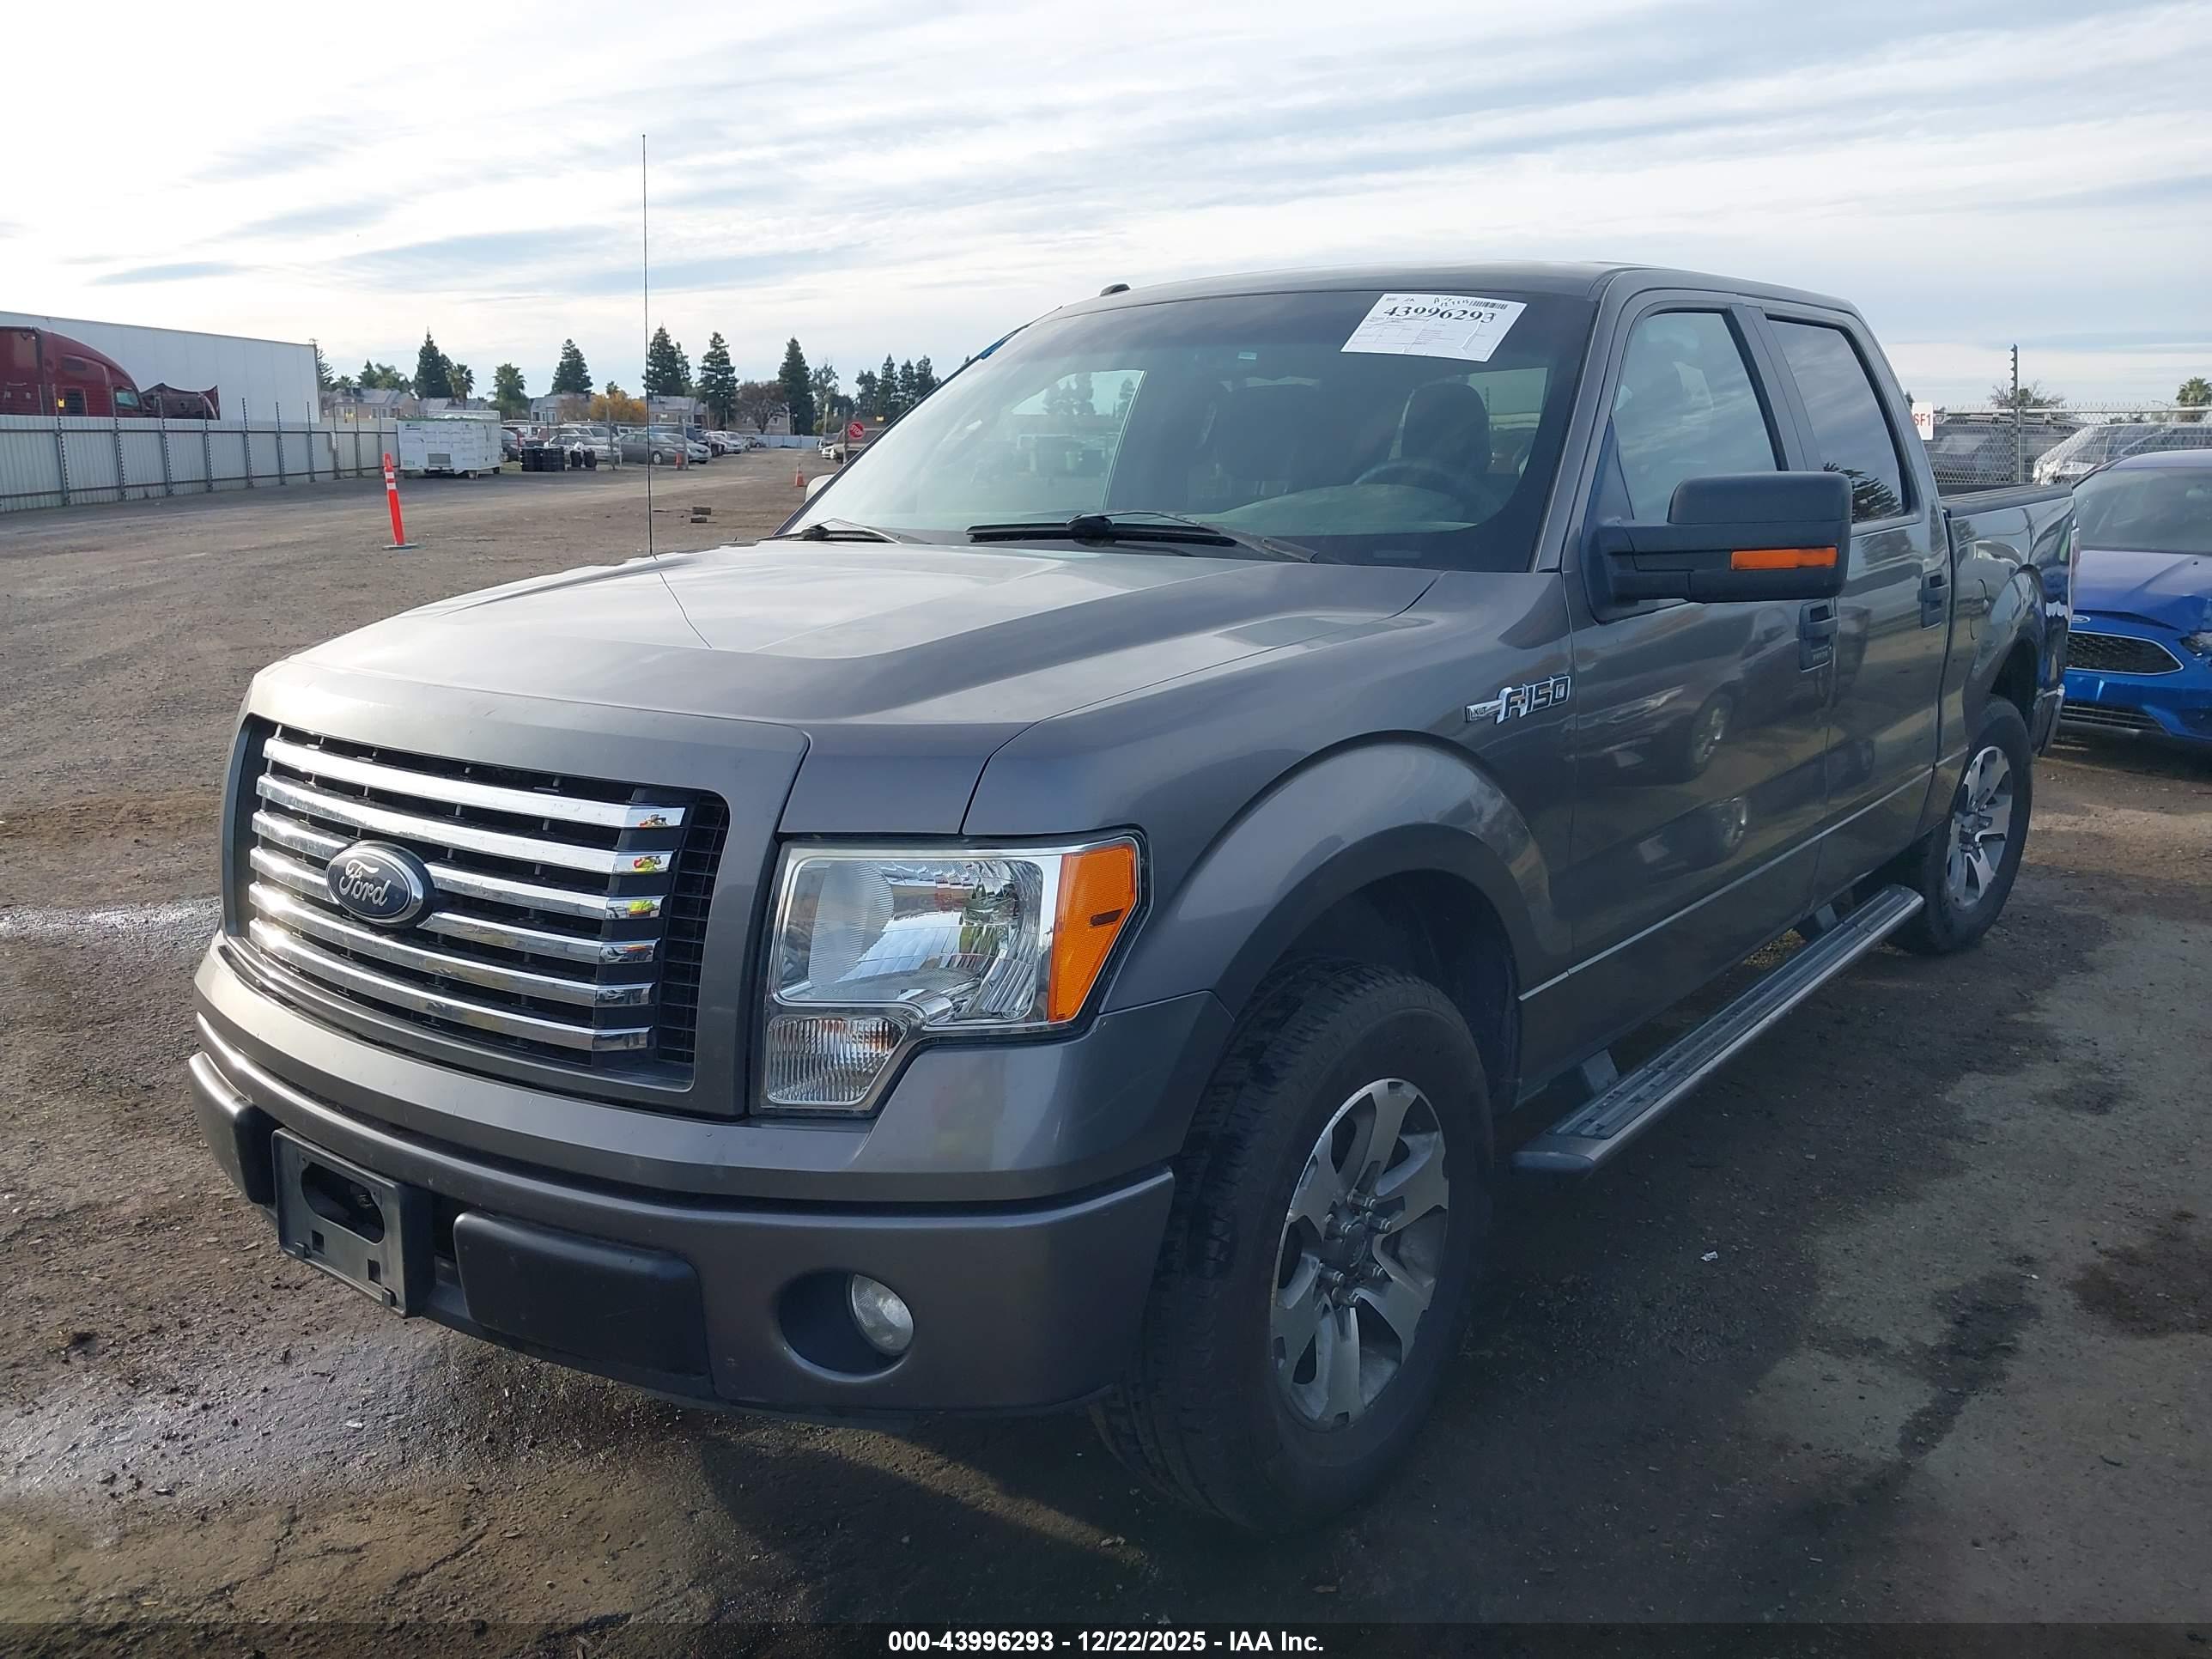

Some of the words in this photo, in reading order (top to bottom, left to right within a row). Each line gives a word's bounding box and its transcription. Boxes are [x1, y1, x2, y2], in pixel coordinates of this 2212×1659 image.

[1382, 306, 1497, 324] 43996293
[850, 423, 863, 436] STOP
[338, 859, 392, 907] Ford
